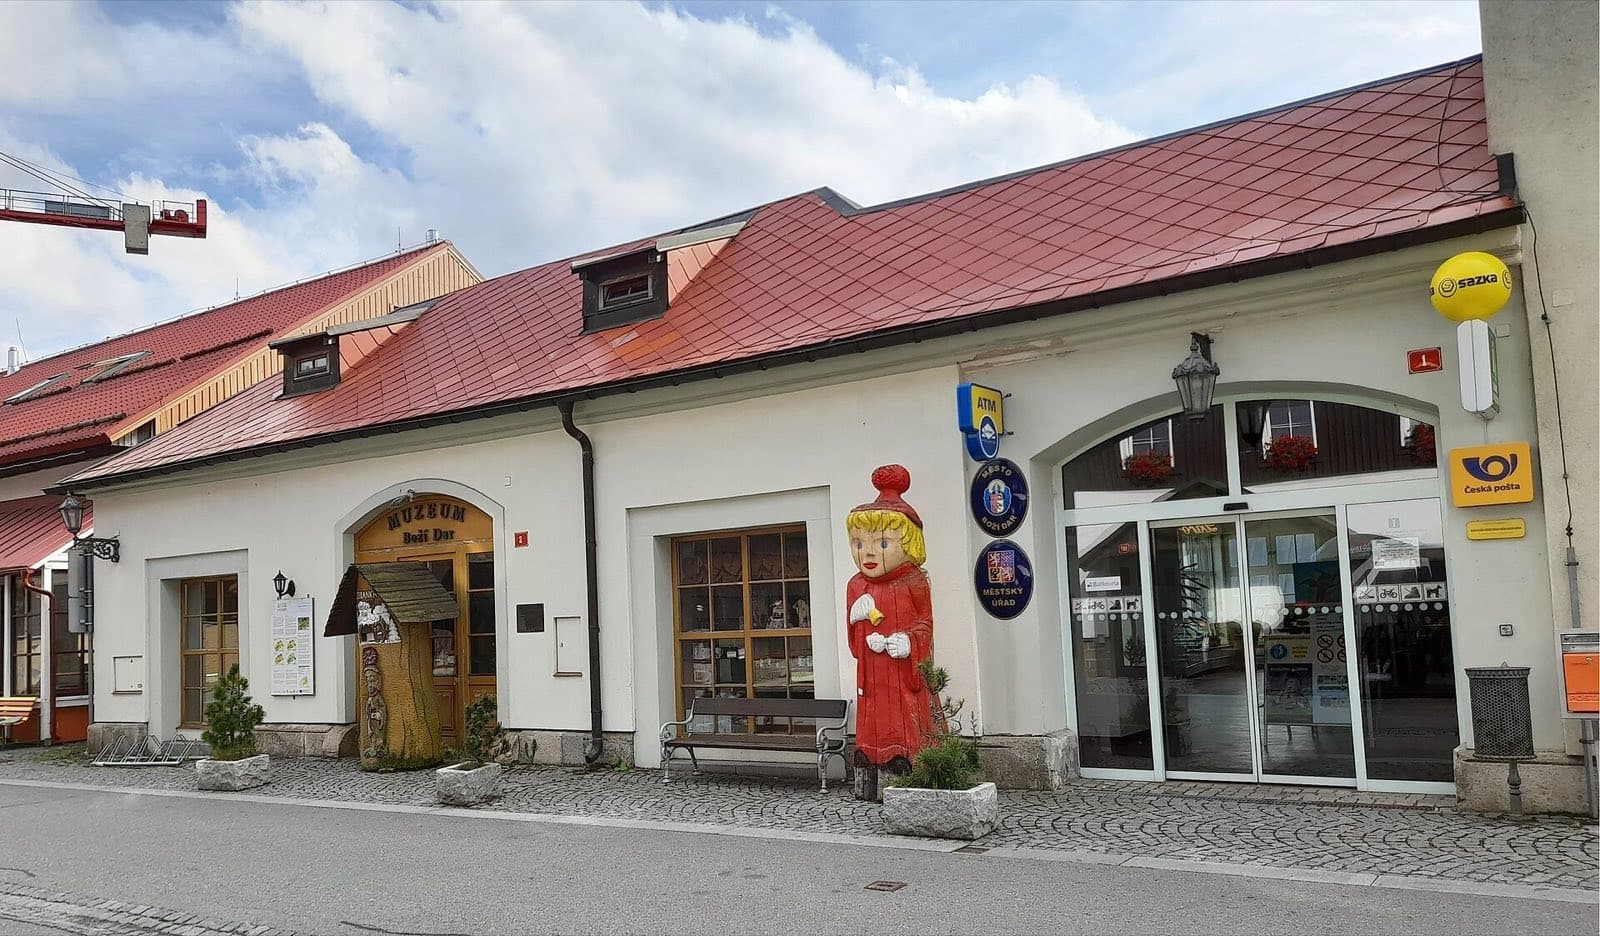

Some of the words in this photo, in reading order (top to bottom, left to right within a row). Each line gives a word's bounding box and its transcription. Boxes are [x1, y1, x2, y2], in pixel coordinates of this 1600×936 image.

[1421, 354, 1427, 367] 1
[977, 396, 997, 412] ATM
[1464, 485, 1493, 494] Česká
[1494, 483, 1521, 493] pošta
[387, 503, 466, 531] MUZEUM
[1001, 514, 1017, 530] DAR
[403, 528, 428, 544] Boží
[432, 528, 455, 541] Dar
[983, 586, 1024, 596] MĚSTSKÝ
